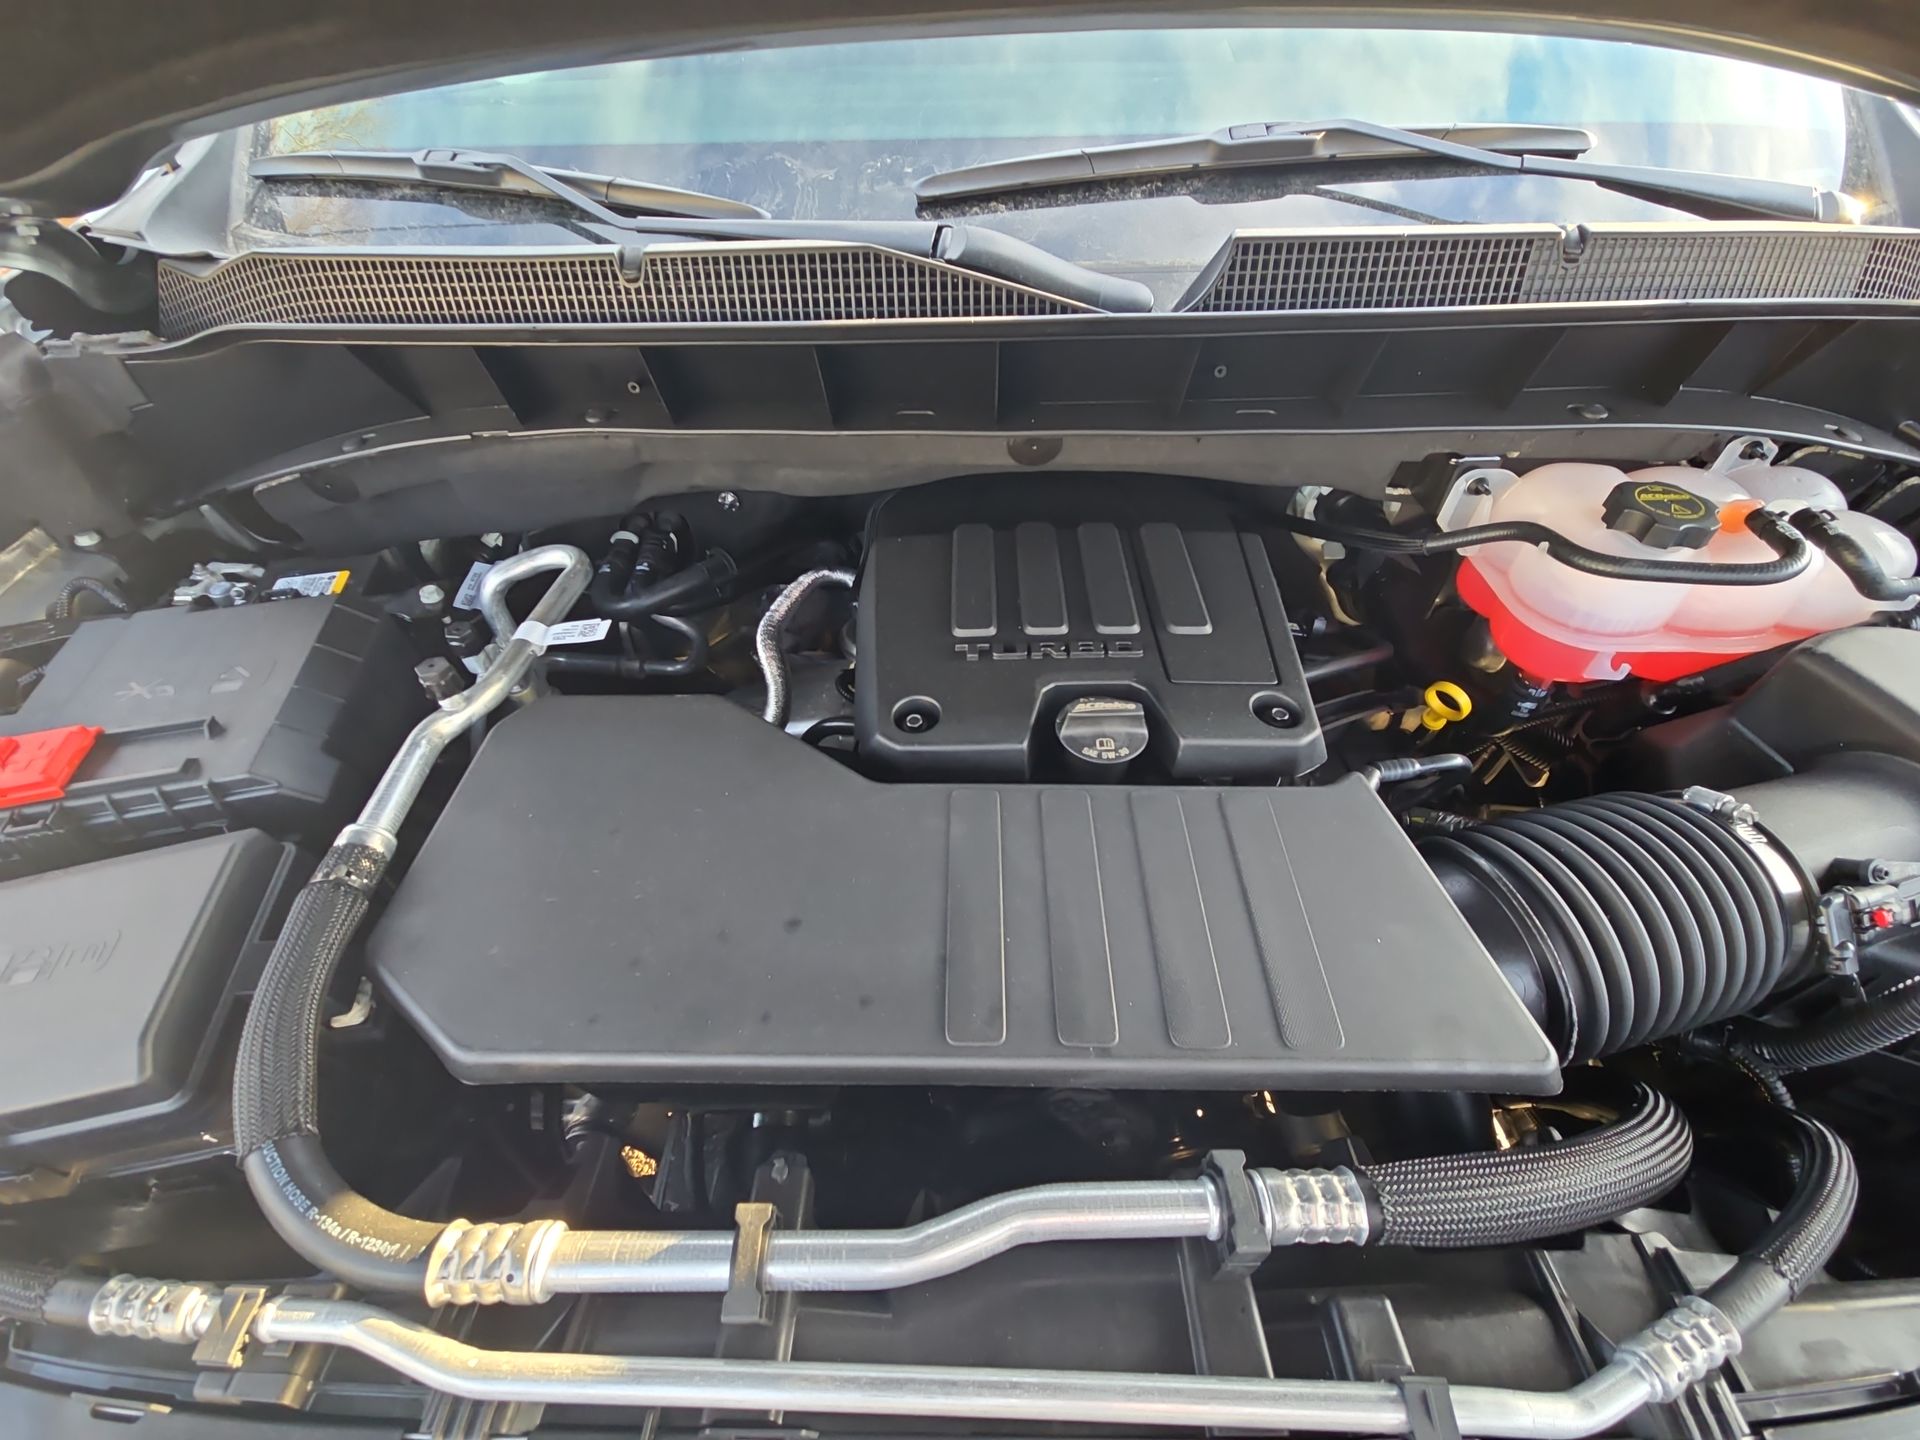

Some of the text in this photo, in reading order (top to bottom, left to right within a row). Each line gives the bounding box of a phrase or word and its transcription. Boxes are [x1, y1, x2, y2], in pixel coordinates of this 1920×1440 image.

[955, 641, 1144, 661] TURBO
[1072, 702, 1136, 713] ACDelco
[283, 1182, 311, 1213] HOSE
[305, 1206, 343, 1238] R-134a
